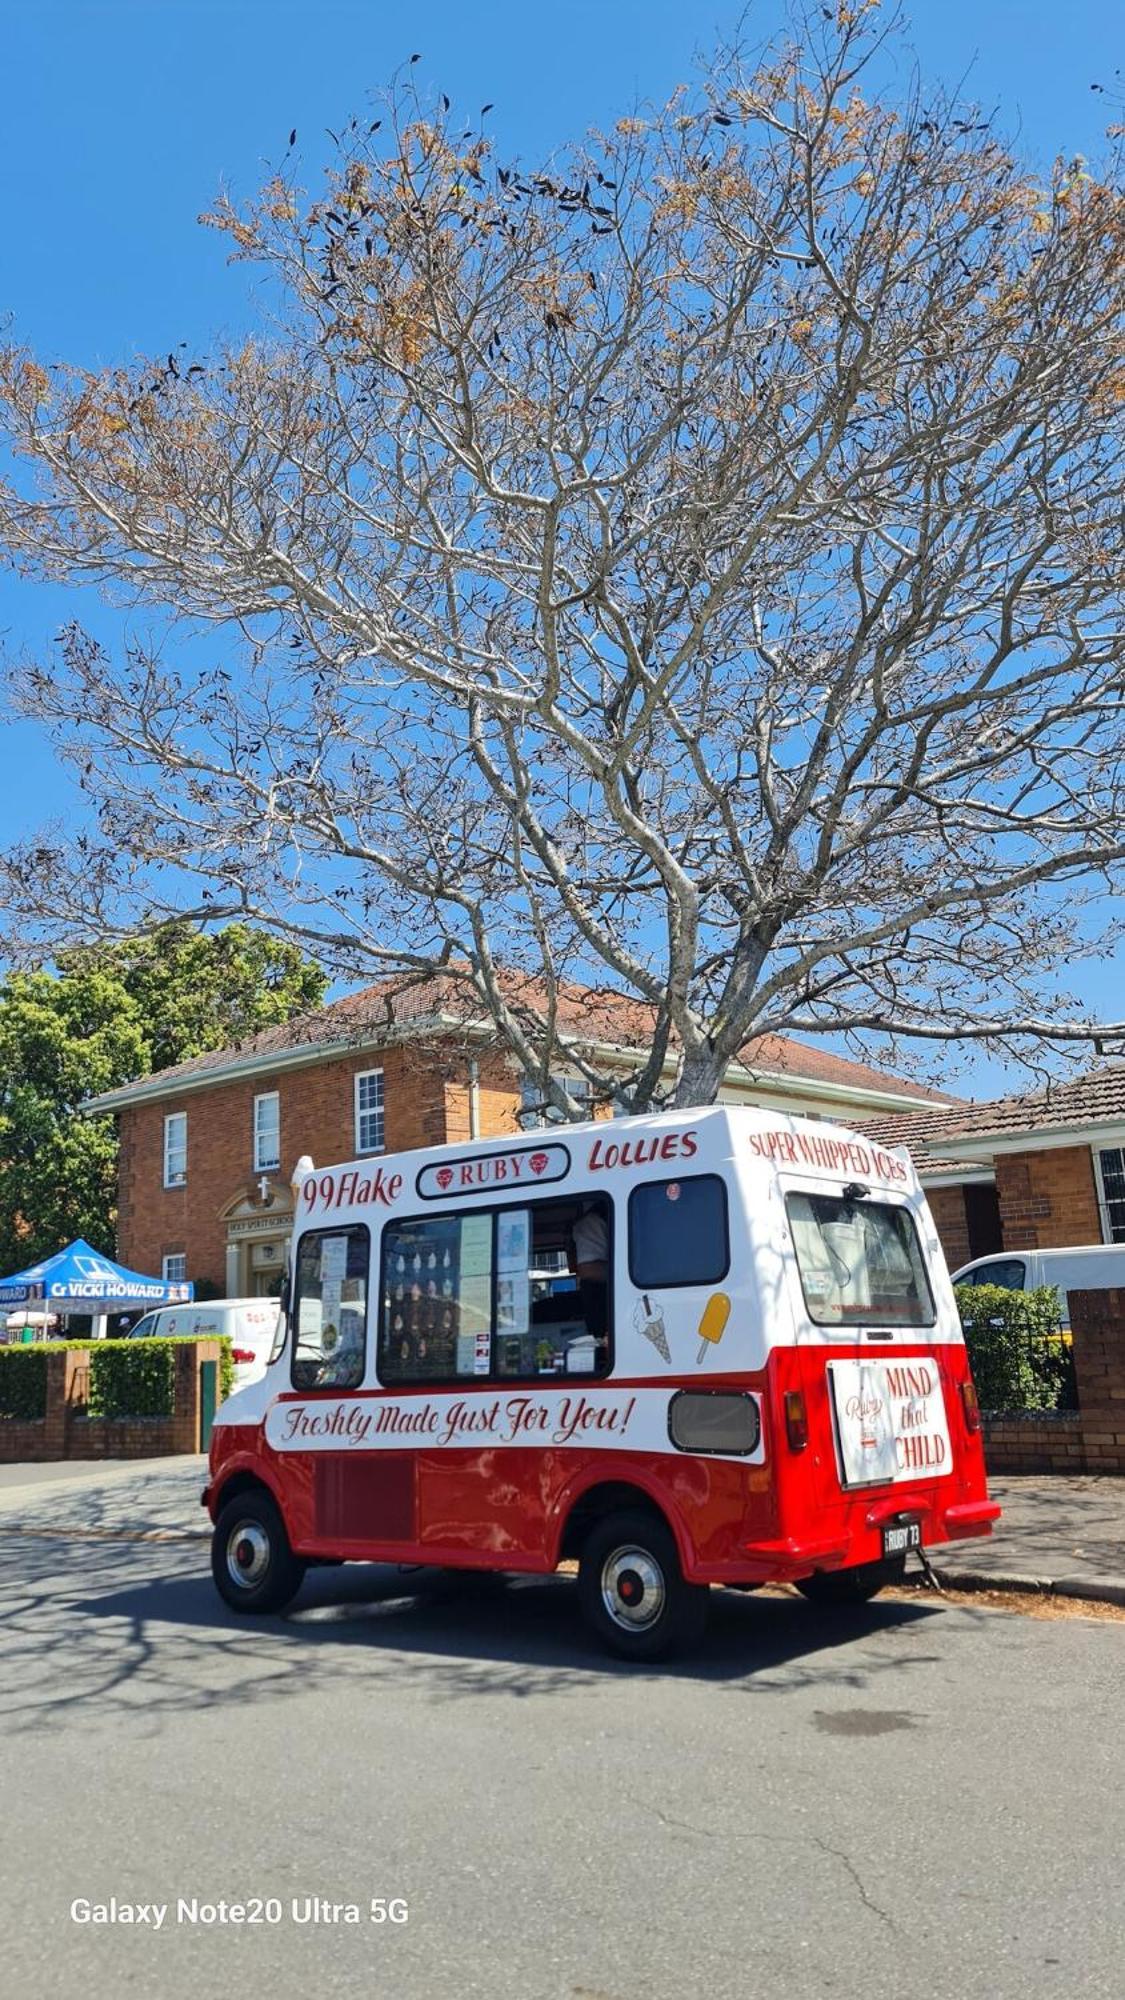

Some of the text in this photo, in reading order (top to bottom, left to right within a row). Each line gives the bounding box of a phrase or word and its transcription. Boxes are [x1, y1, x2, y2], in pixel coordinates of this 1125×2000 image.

[587, 1130, 699, 1172] LOLLIES
[749, 1131, 799, 1163] SUPER
[796, 1133, 871, 1175] WHIPPED
[459, 1154, 525, 1185] RUBY
[269, 1215, 294, 1226] SCHOO
[51, 1283, 164, 1298] Cr VICKI HOWARD
[886, 1367, 932, 1398] MIND
[281, 1396, 637, 1446] Freshly Made Just For You!
[901, 1400, 928, 1430] that
[895, 1434, 945, 1469] CHILD
